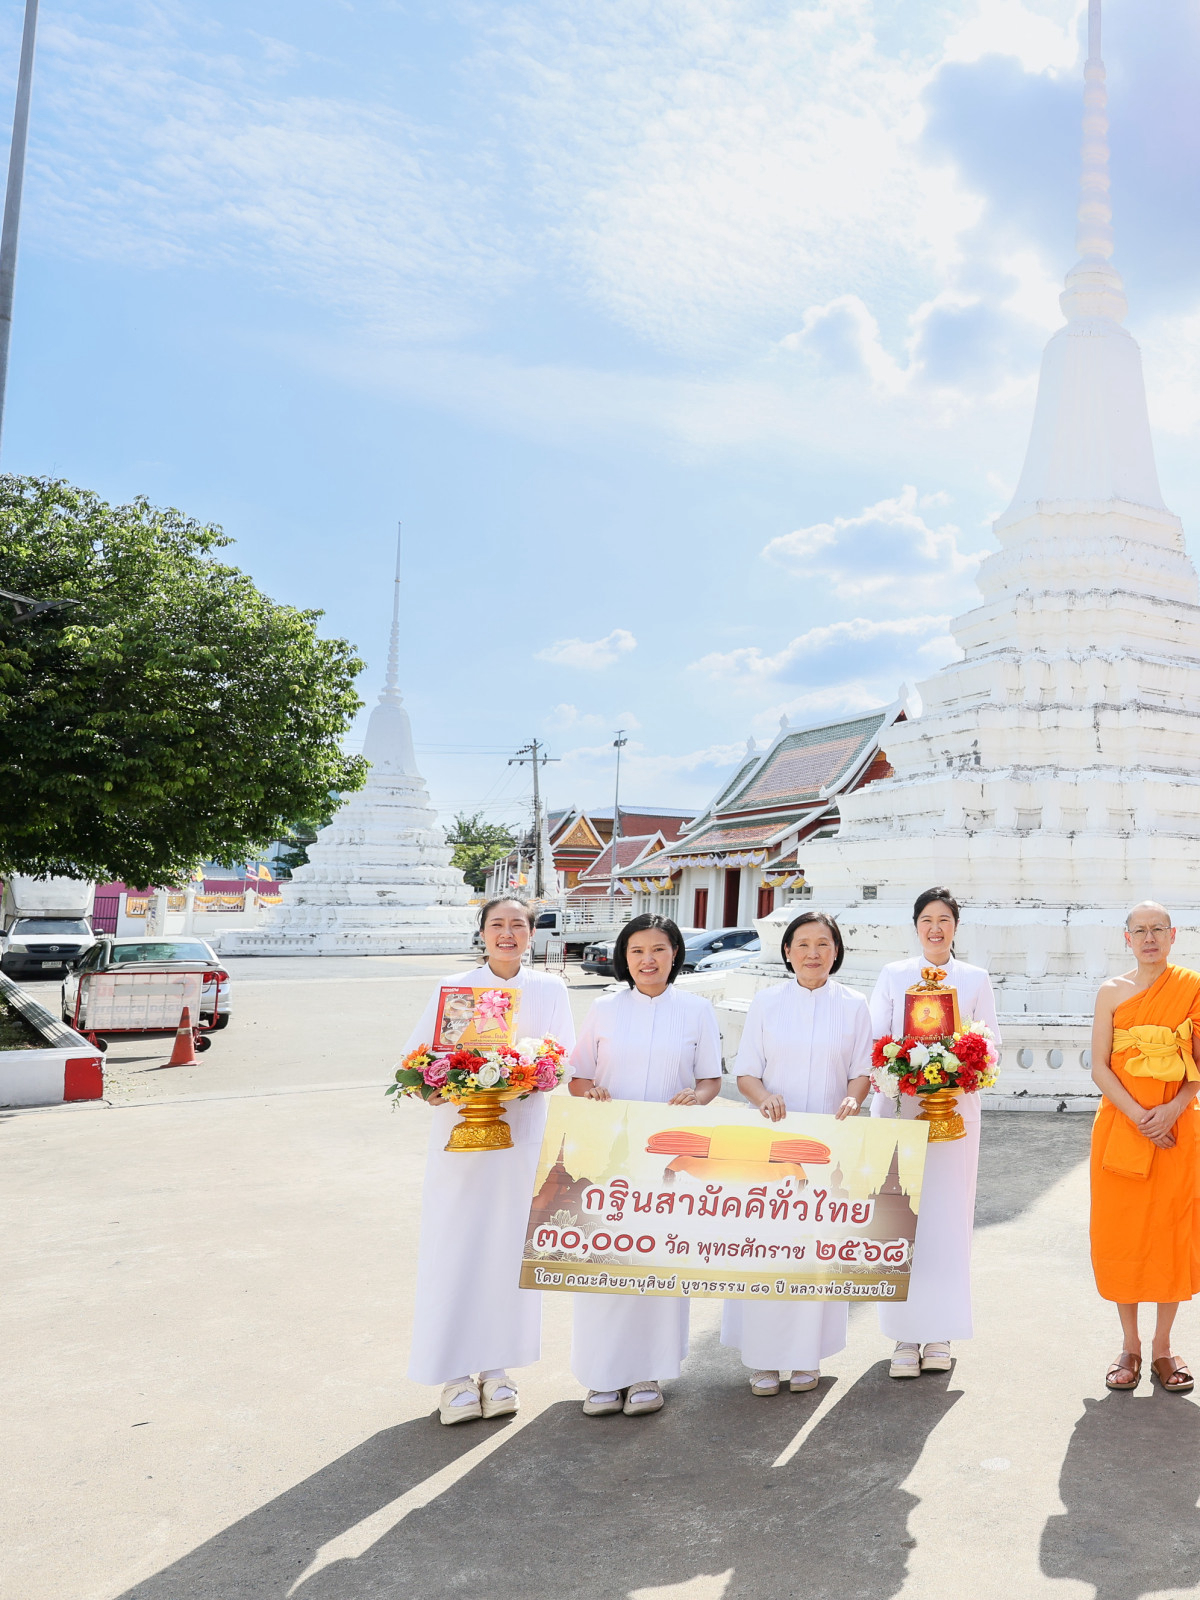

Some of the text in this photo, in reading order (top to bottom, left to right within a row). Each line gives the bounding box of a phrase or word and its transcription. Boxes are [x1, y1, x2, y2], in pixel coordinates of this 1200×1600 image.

[585, 1178, 871, 1224] กฐินสามัคคีทั่วไทย
[536, 1228, 905, 1264] ๓๐,๐๐๐ วัด พุทธศักราช ๒๕๖๘
[536, 1268, 897, 1296] โดย คณะศิษยานุศิษย์ บูชาธรรม ๘๑ ปี หลวงพ่อธัมมชโย
